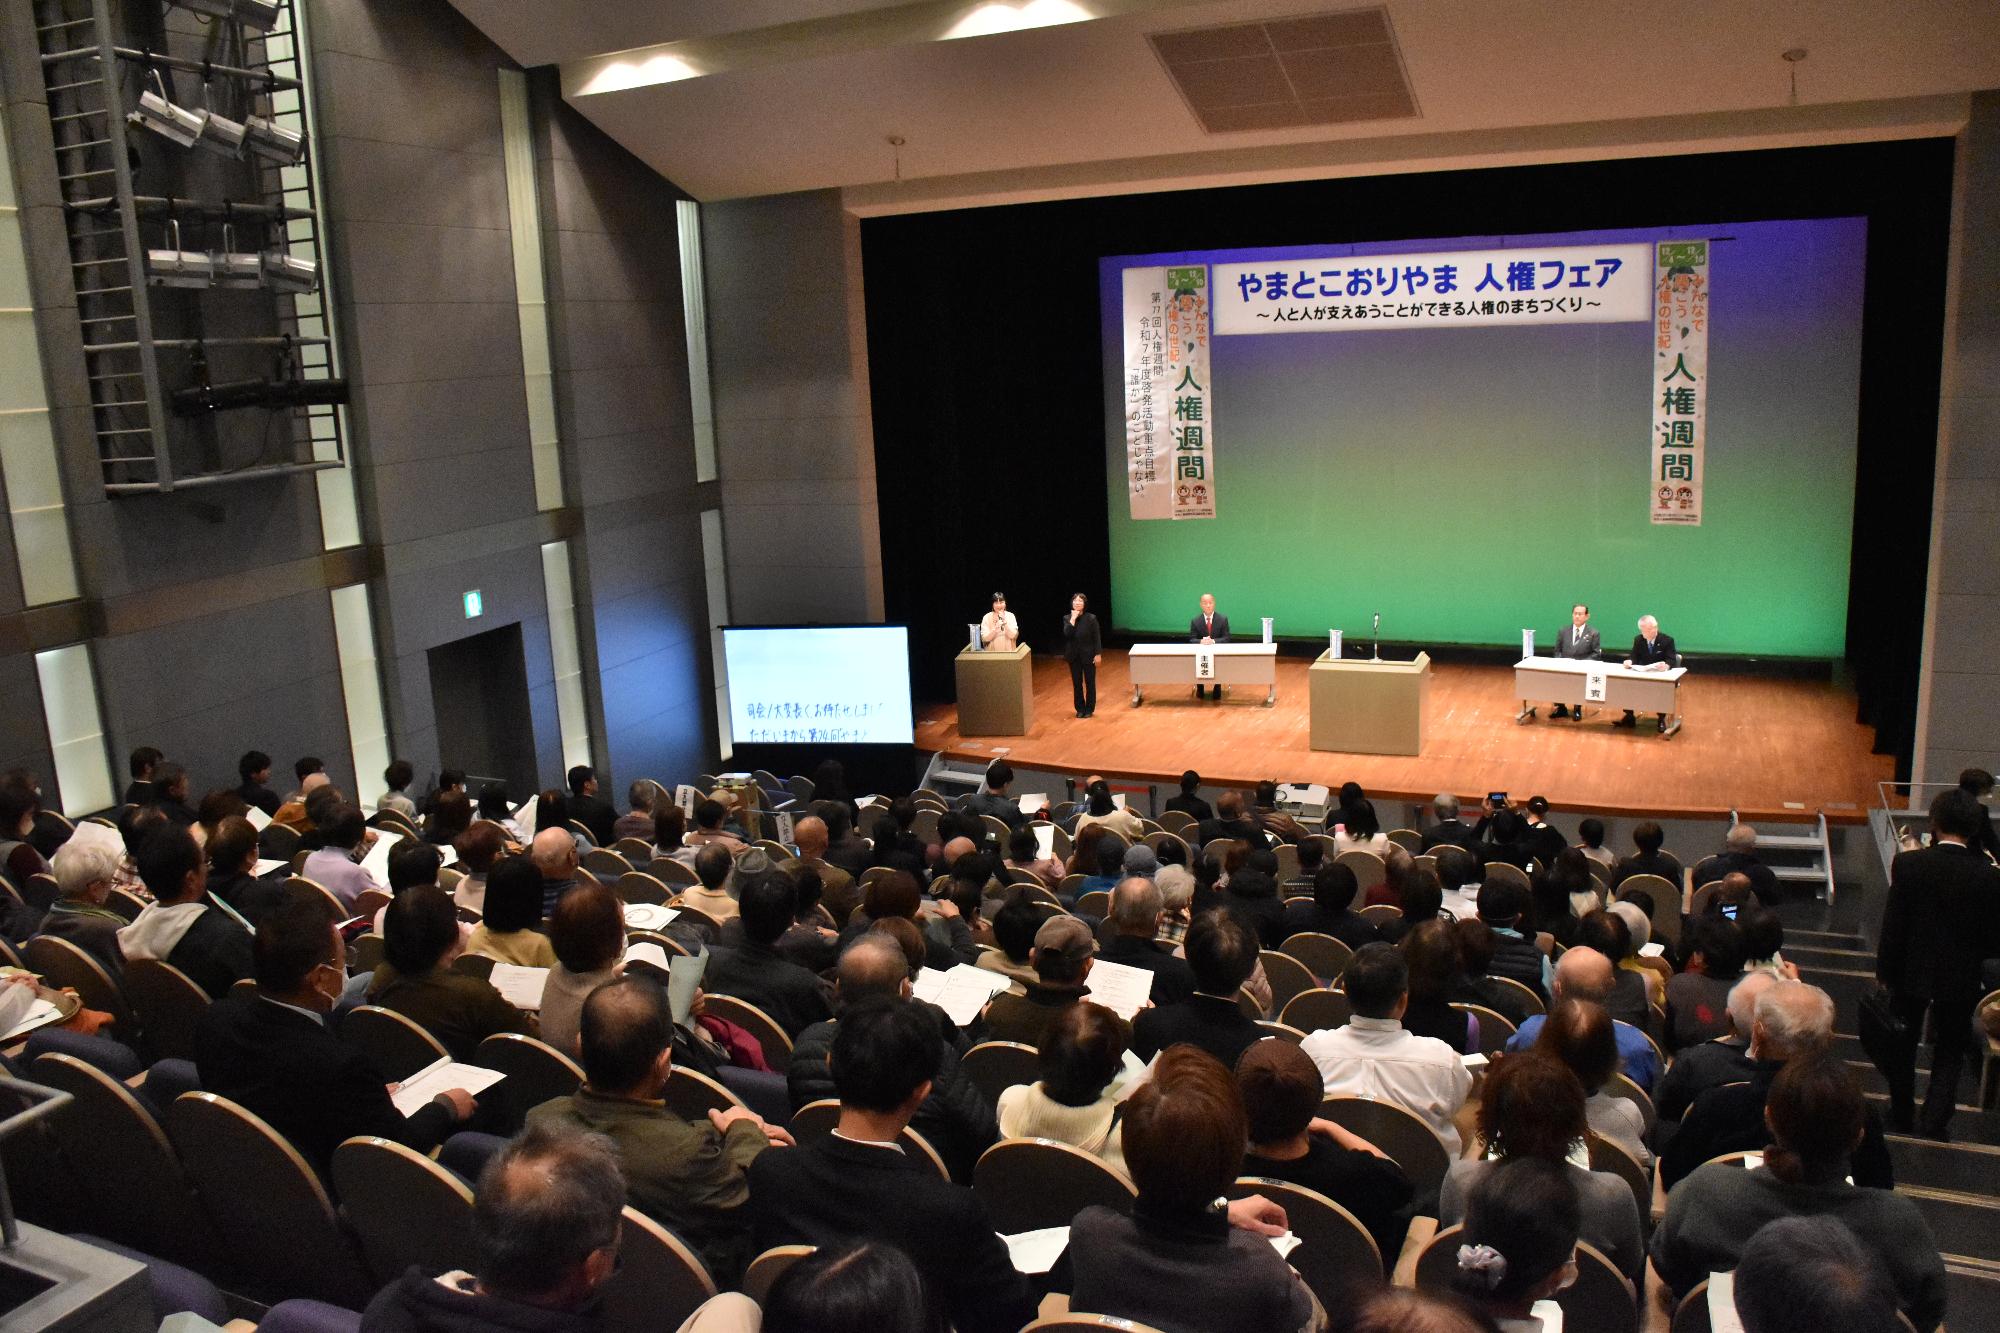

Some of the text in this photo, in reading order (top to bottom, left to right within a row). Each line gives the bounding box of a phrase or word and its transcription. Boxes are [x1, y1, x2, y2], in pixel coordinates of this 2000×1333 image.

[1238, 258, 1623, 302] やまとこおりやま 人権フェア
[1658, 275, 1672, 348] 人権の世紀
[1151, 292, 1163, 377] 第77回人権週間
[1167, 297, 1180, 362] 人権の世紀
[1174, 365, 1205, 481] 人権週間
[1661, 352, 1697, 481] 人権週間
[1590, 675, 1602, 699] 来賓
